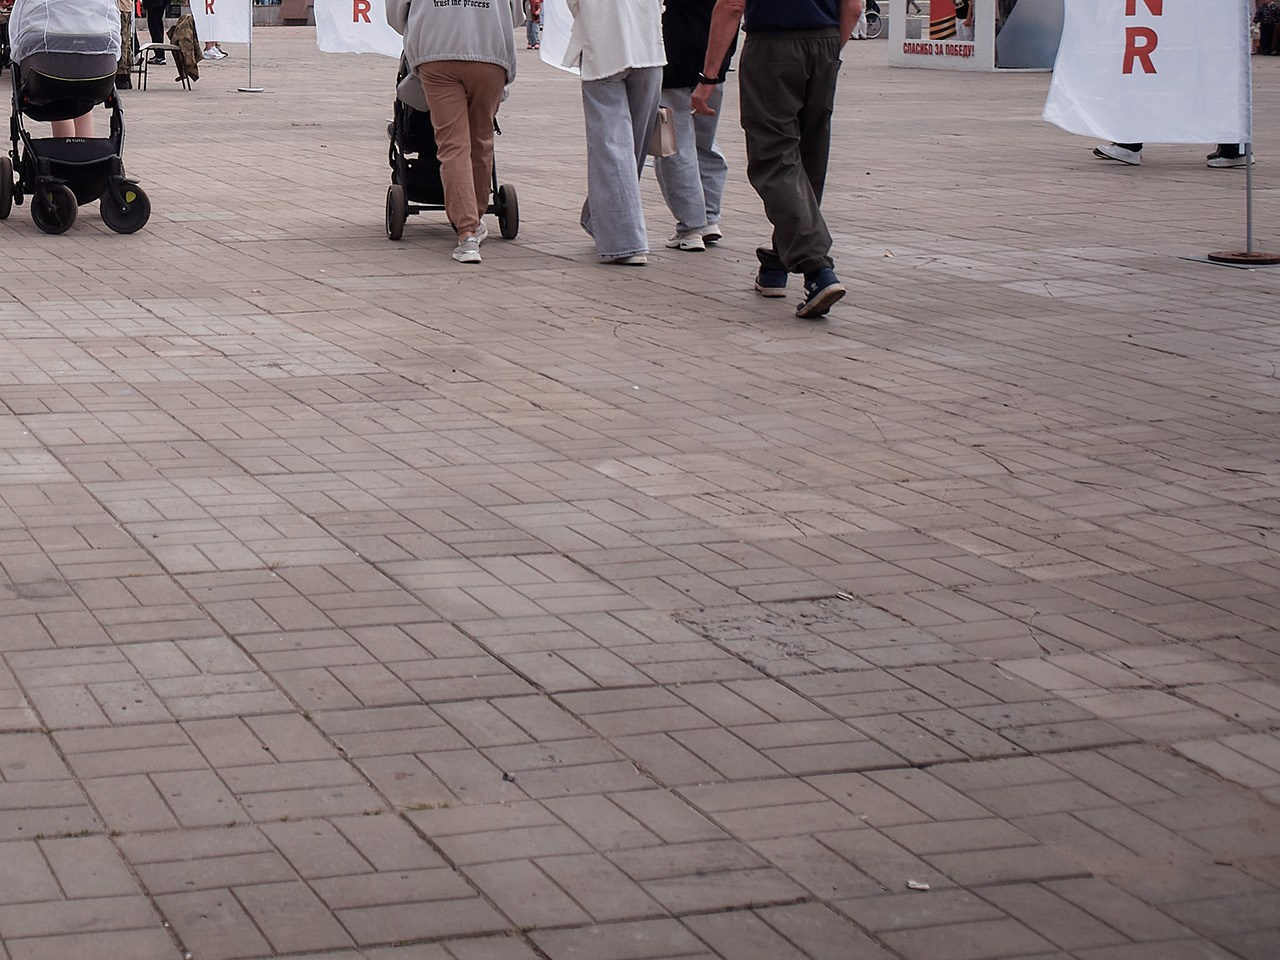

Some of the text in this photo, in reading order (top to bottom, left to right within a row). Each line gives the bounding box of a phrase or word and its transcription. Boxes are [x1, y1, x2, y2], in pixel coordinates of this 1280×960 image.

[433, 0, 450, 7] trust
[463, 0, 490, 9] process
[902, 42, 933, 55] СПАСИБО
[934, 43, 944, 55] ЗА
